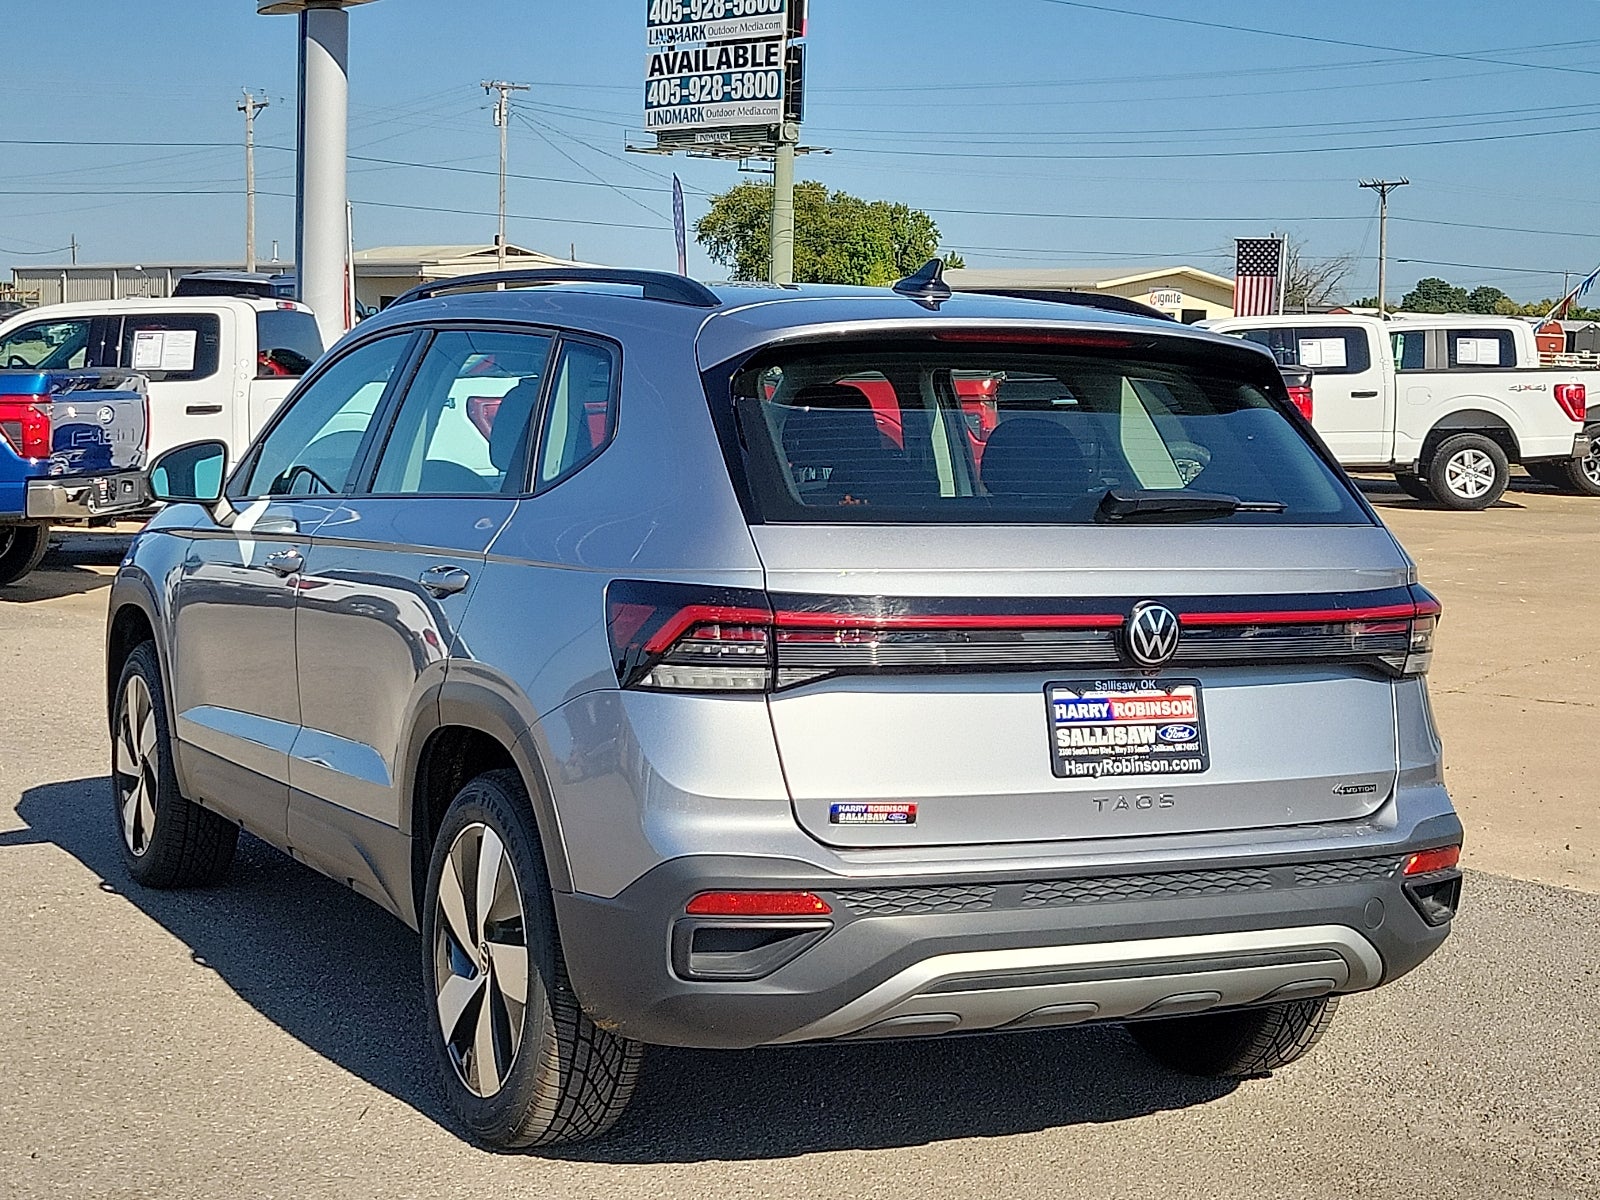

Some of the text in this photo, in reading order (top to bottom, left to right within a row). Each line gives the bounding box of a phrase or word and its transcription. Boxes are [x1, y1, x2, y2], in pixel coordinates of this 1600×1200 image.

[648, 20, 781, 46] LINDMARK Outdoor Media.com
[649, 43, 779, 78] AVAILABLE
[647, 71, 779, 106] 405-928-5800
[647, 105, 779, 127] LINDMARK Outdoor Media.com
[1157, 293, 1182, 306] ignite
[1094, 679, 1157, 693] Sallisaw, OK
[1054, 700, 1194, 720] HARRY ROBINSON
[1056, 725, 1157, 747] SALLISAW
[1065, 758, 1201, 777] HarryRobinson.com
[838, 804, 909, 813] HARRY ROBINSON
[1093, 793, 1175, 812] TAOS
[838, 812, 887, 821] SALLISAW
